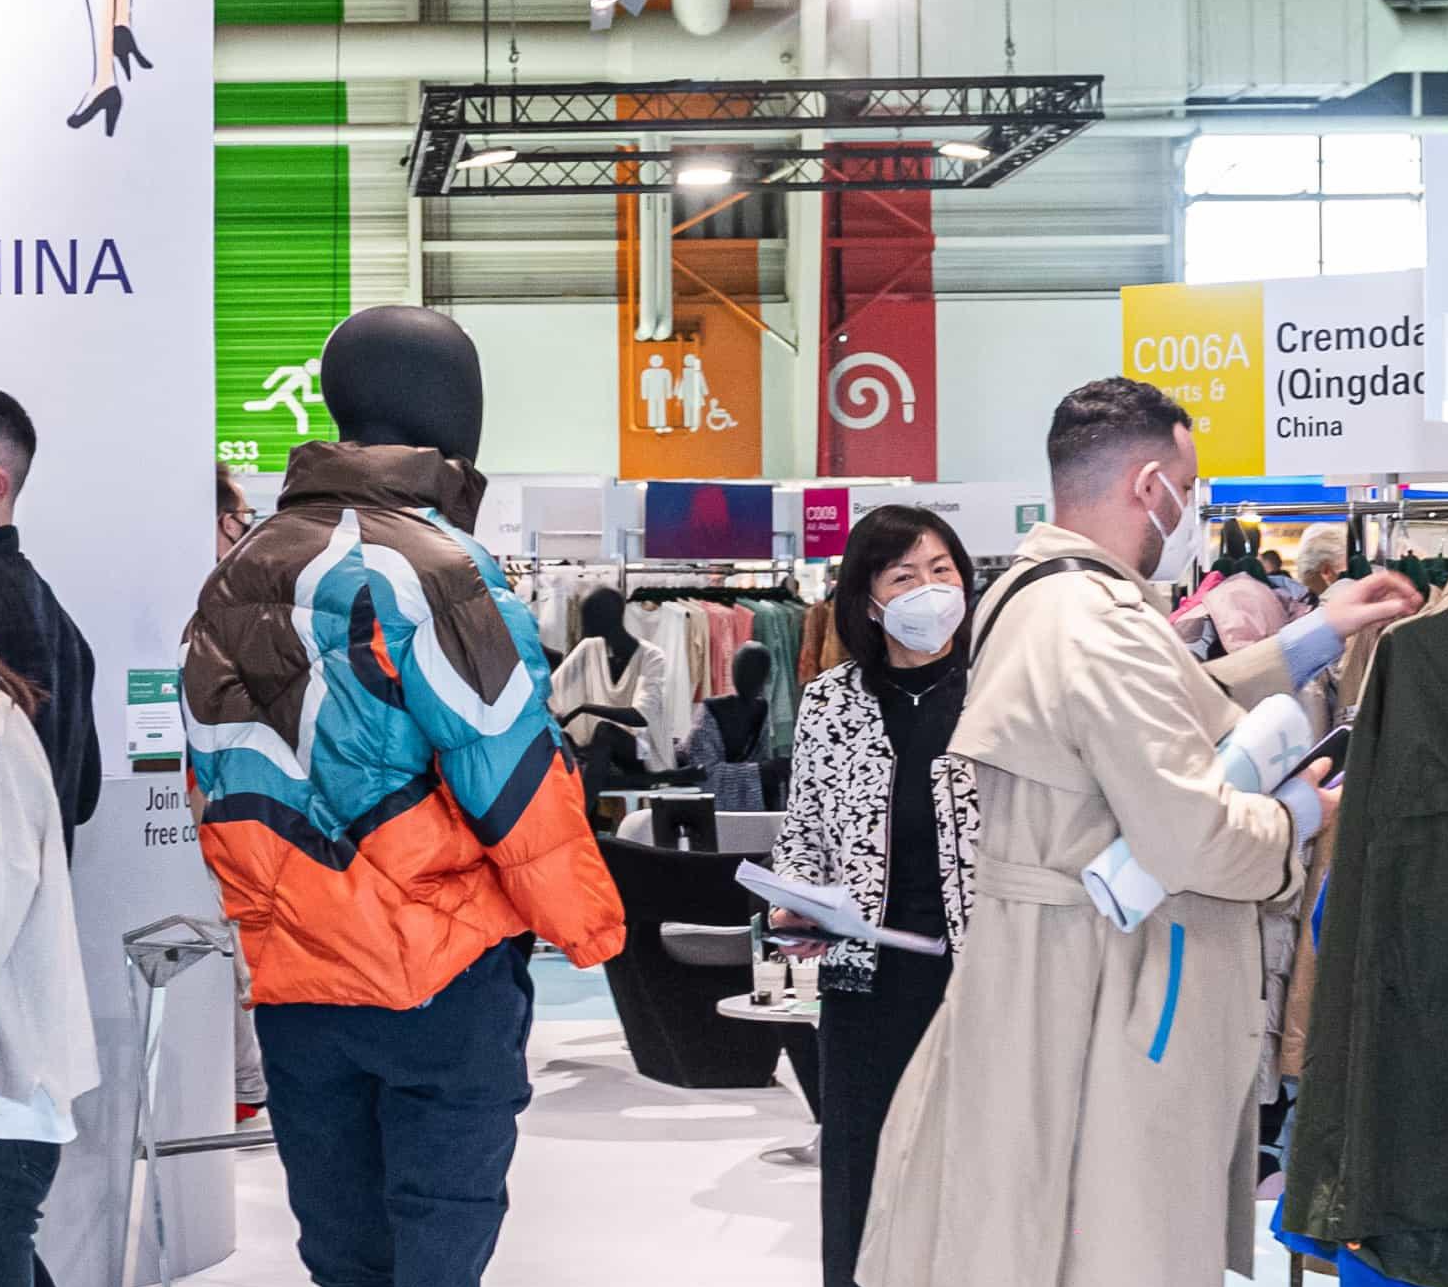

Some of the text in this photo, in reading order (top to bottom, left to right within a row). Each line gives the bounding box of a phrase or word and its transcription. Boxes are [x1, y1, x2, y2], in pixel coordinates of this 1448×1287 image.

[1133, 332, 1251, 374] C006A
[1165, 378, 1226, 403] orts &
[1276, 416, 1343, 439] China
[217, 441, 259, 461] S33
[806, 505, 838, 521] C009
[145, 786, 180, 812] Join
[144, 821, 178, 847] free
